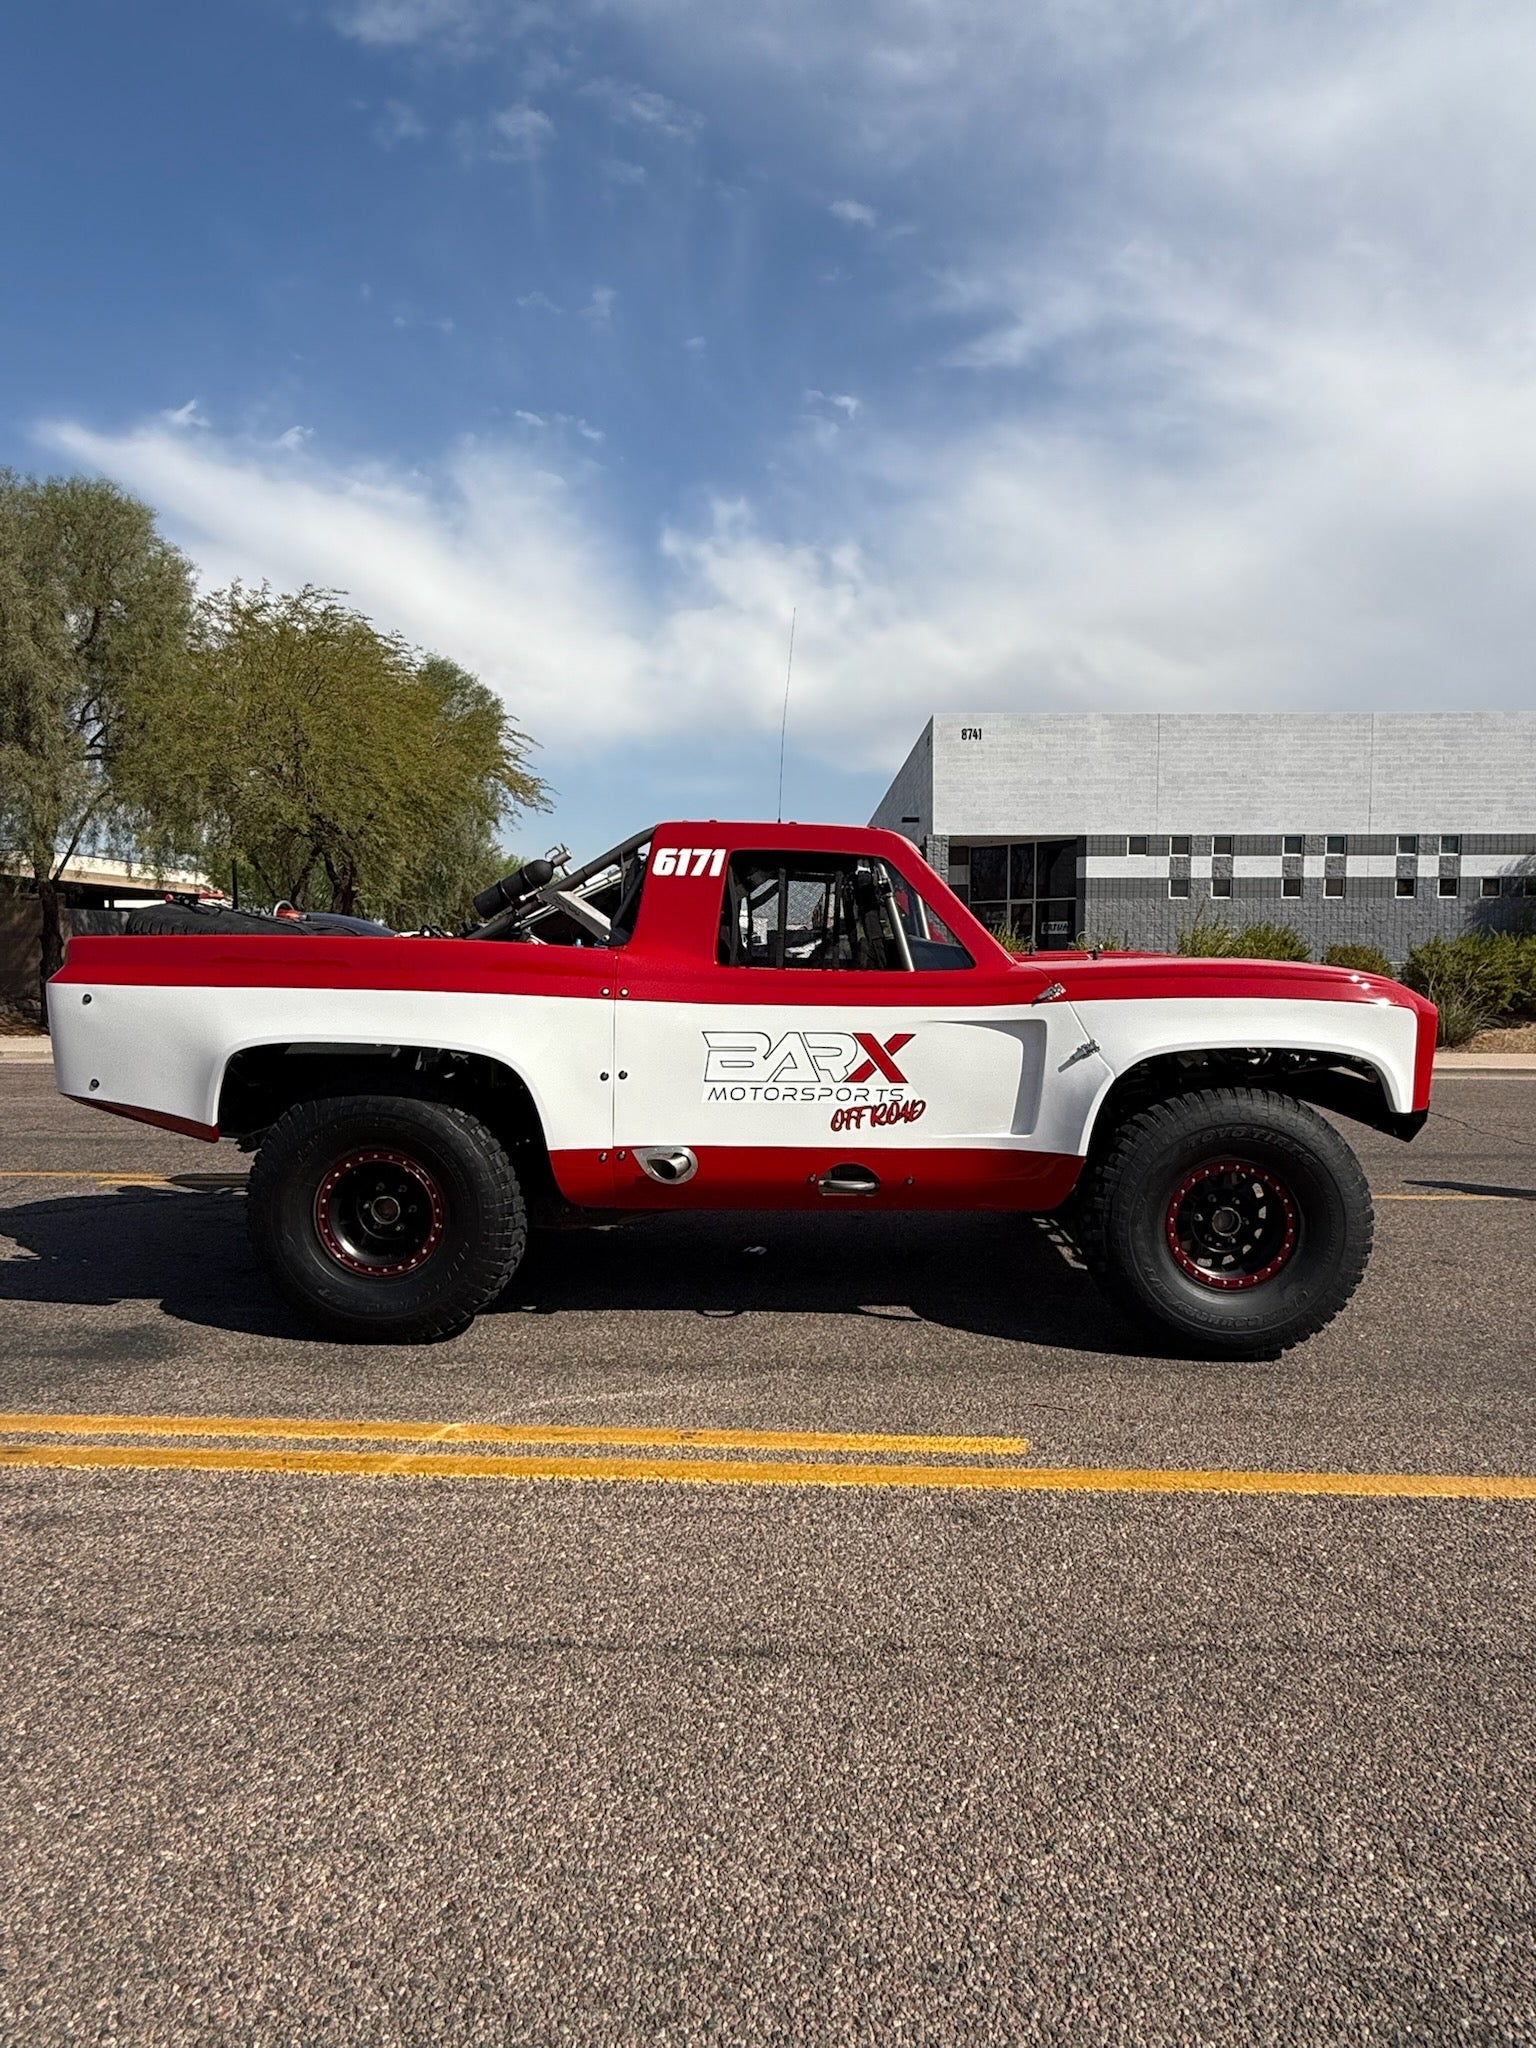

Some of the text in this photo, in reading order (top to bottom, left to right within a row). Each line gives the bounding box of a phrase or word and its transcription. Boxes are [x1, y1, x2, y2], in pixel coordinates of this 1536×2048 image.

[961, 728, 982, 741] 8741
[652, 847, 727, 877] 6171
[702, 1031, 917, 1084] BARX
[707, 1086, 905, 1103] MOTORSPORTS
